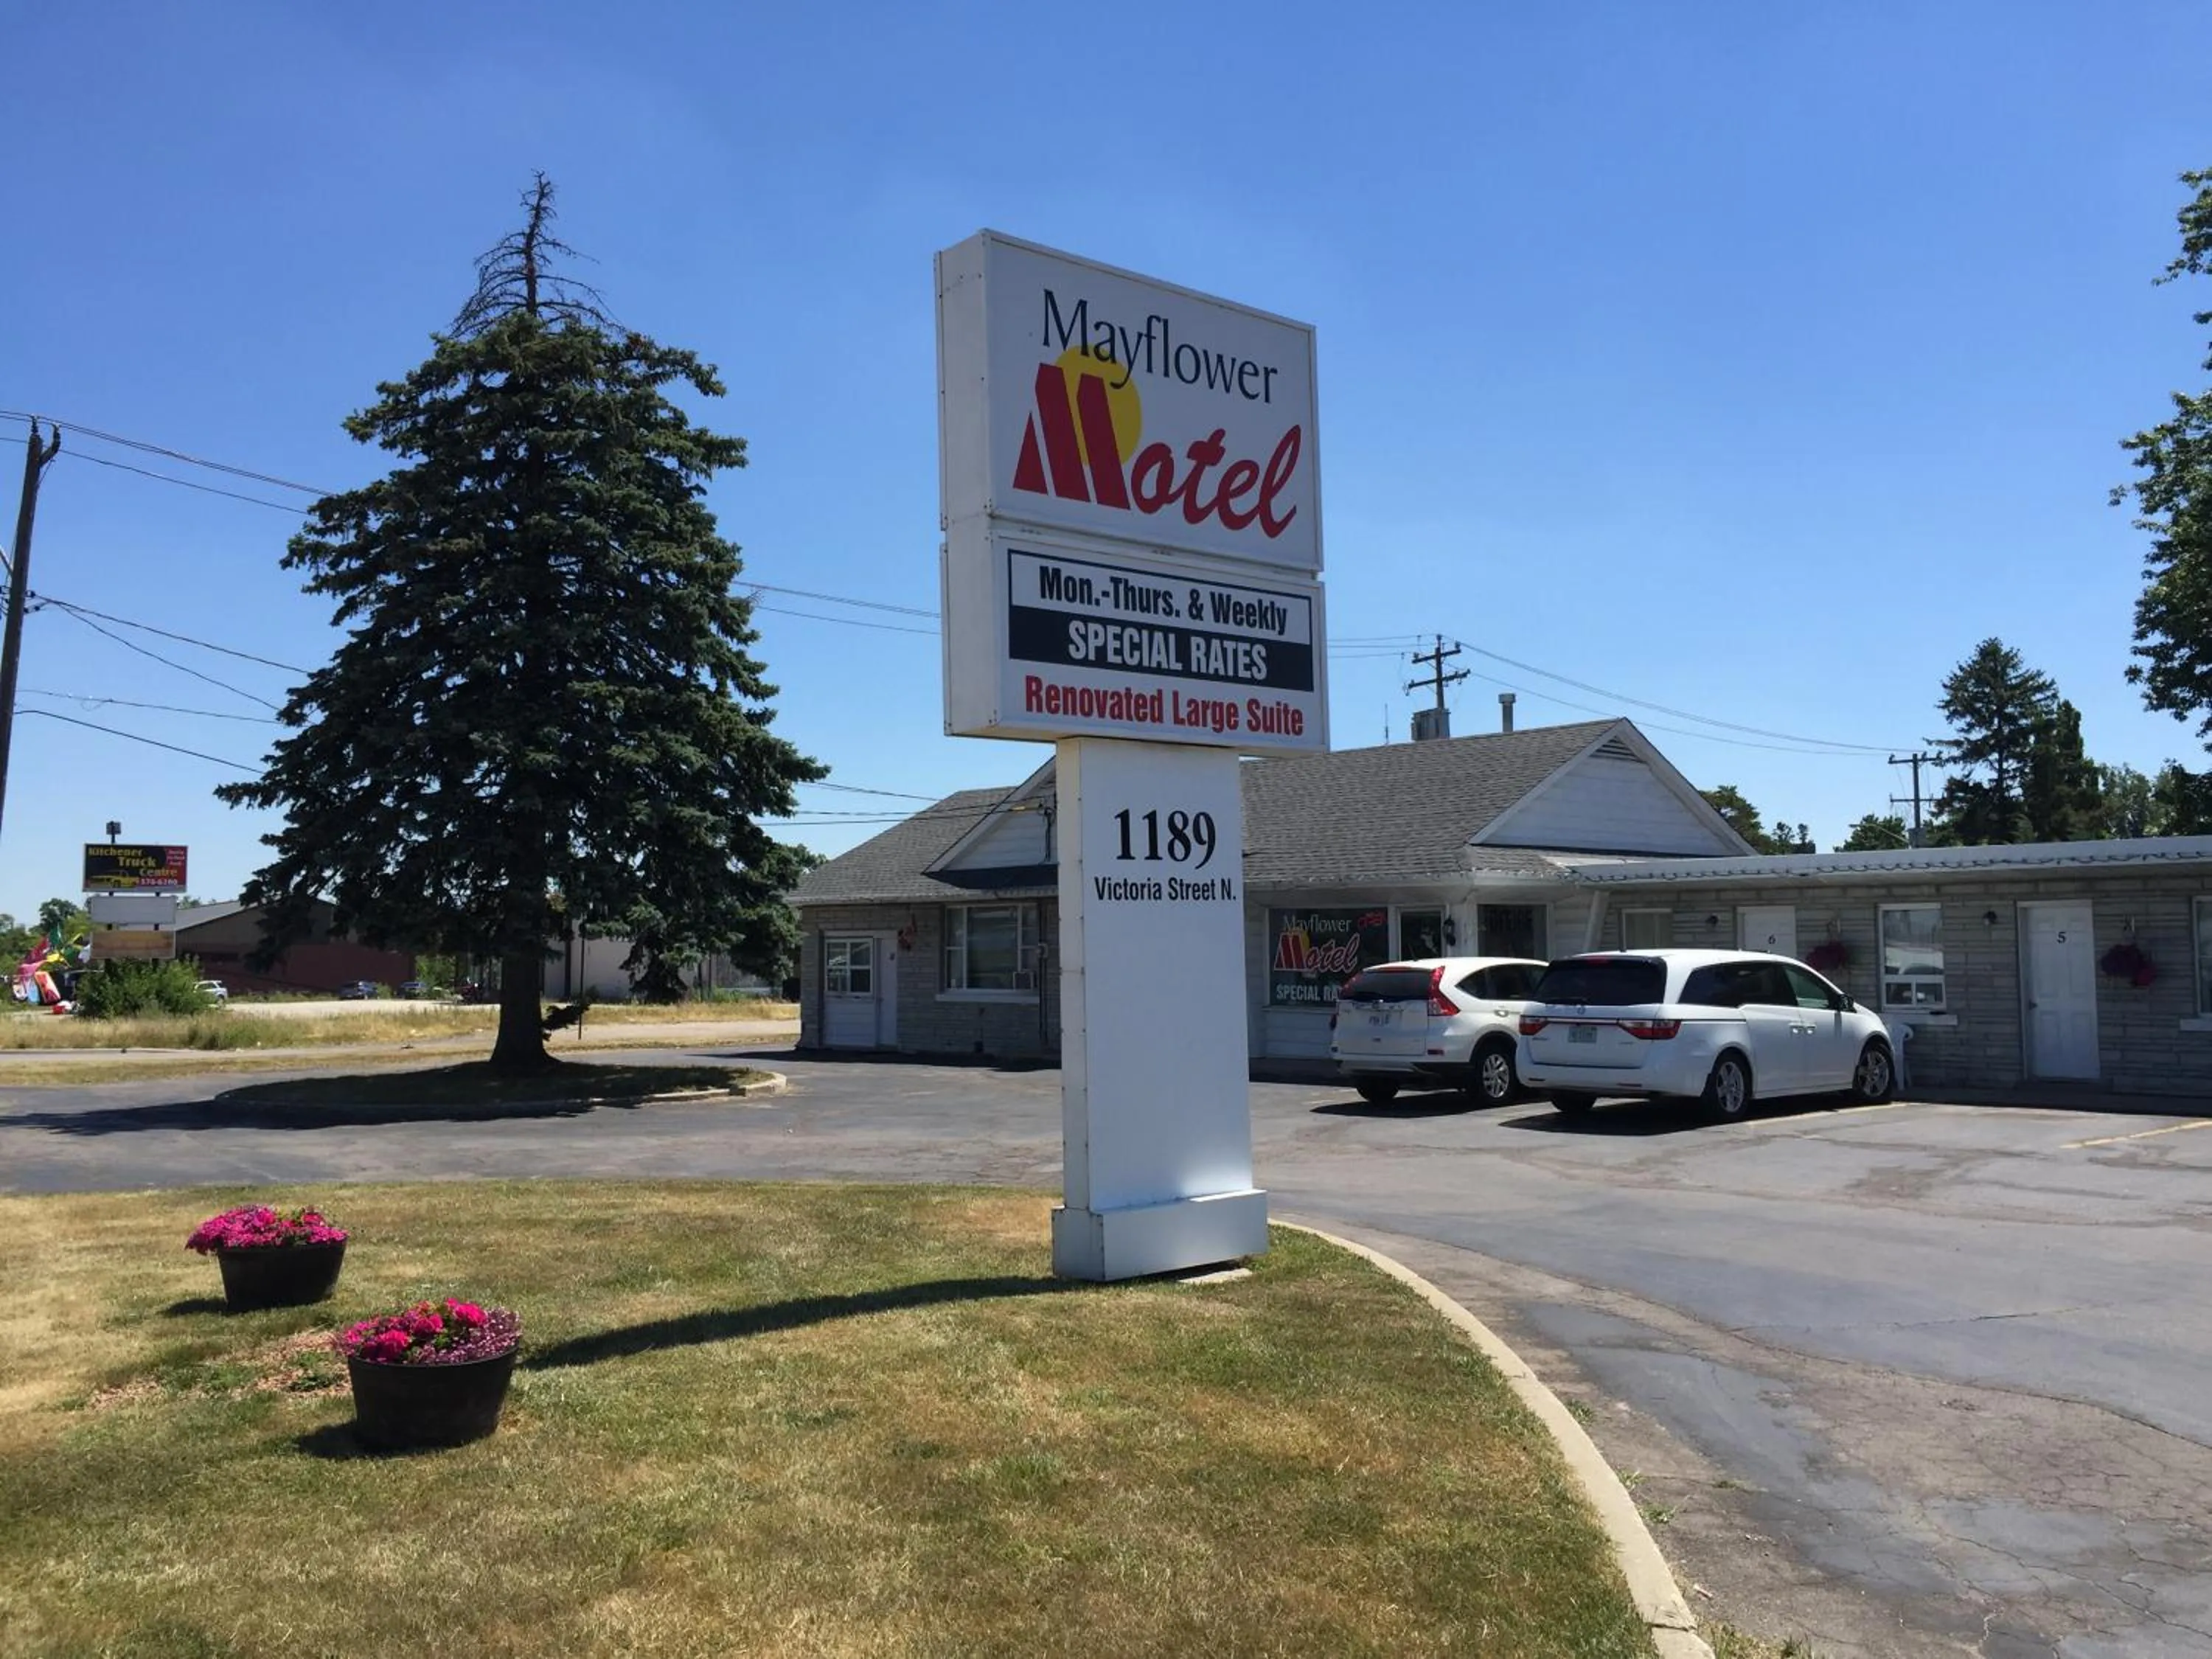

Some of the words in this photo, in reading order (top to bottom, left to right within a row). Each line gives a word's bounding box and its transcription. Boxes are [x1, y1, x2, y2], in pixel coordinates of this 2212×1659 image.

[1042, 288, 1278, 404] Mayflower
[1012, 361, 1301, 538] Motel
[1039, 566, 1180, 618] Mon.-Thurs.
[1188, 588, 1205, 621] &
[1210, 592, 1287, 636] Weekly
[1068, 621, 1183, 671] SPECIAL
[1190, 636, 1267, 681] RATES
[1025, 675, 1164, 723] Renovated
[1173, 691, 1239, 733] Large
[1247, 699, 1304, 736] Suite
[88, 847, 143, 857] Kitchener
[1114, 808, 1217, 869] 1189
[118, 856, 157, 868] Truck
[139, 867, 178, 877] Centre
[1094, 876, 1163, 901] Victoria
[1168, 877, 1216, 900] Street
[1220, 877, 1237, 900] N.
[1282, 914, 1352, 933] Mayflower
[2056, 931, 2066, 944] 5
[1274, 931, 1360, 973] Motel
[1276, 983, 1321, 1001] SPECIAL
